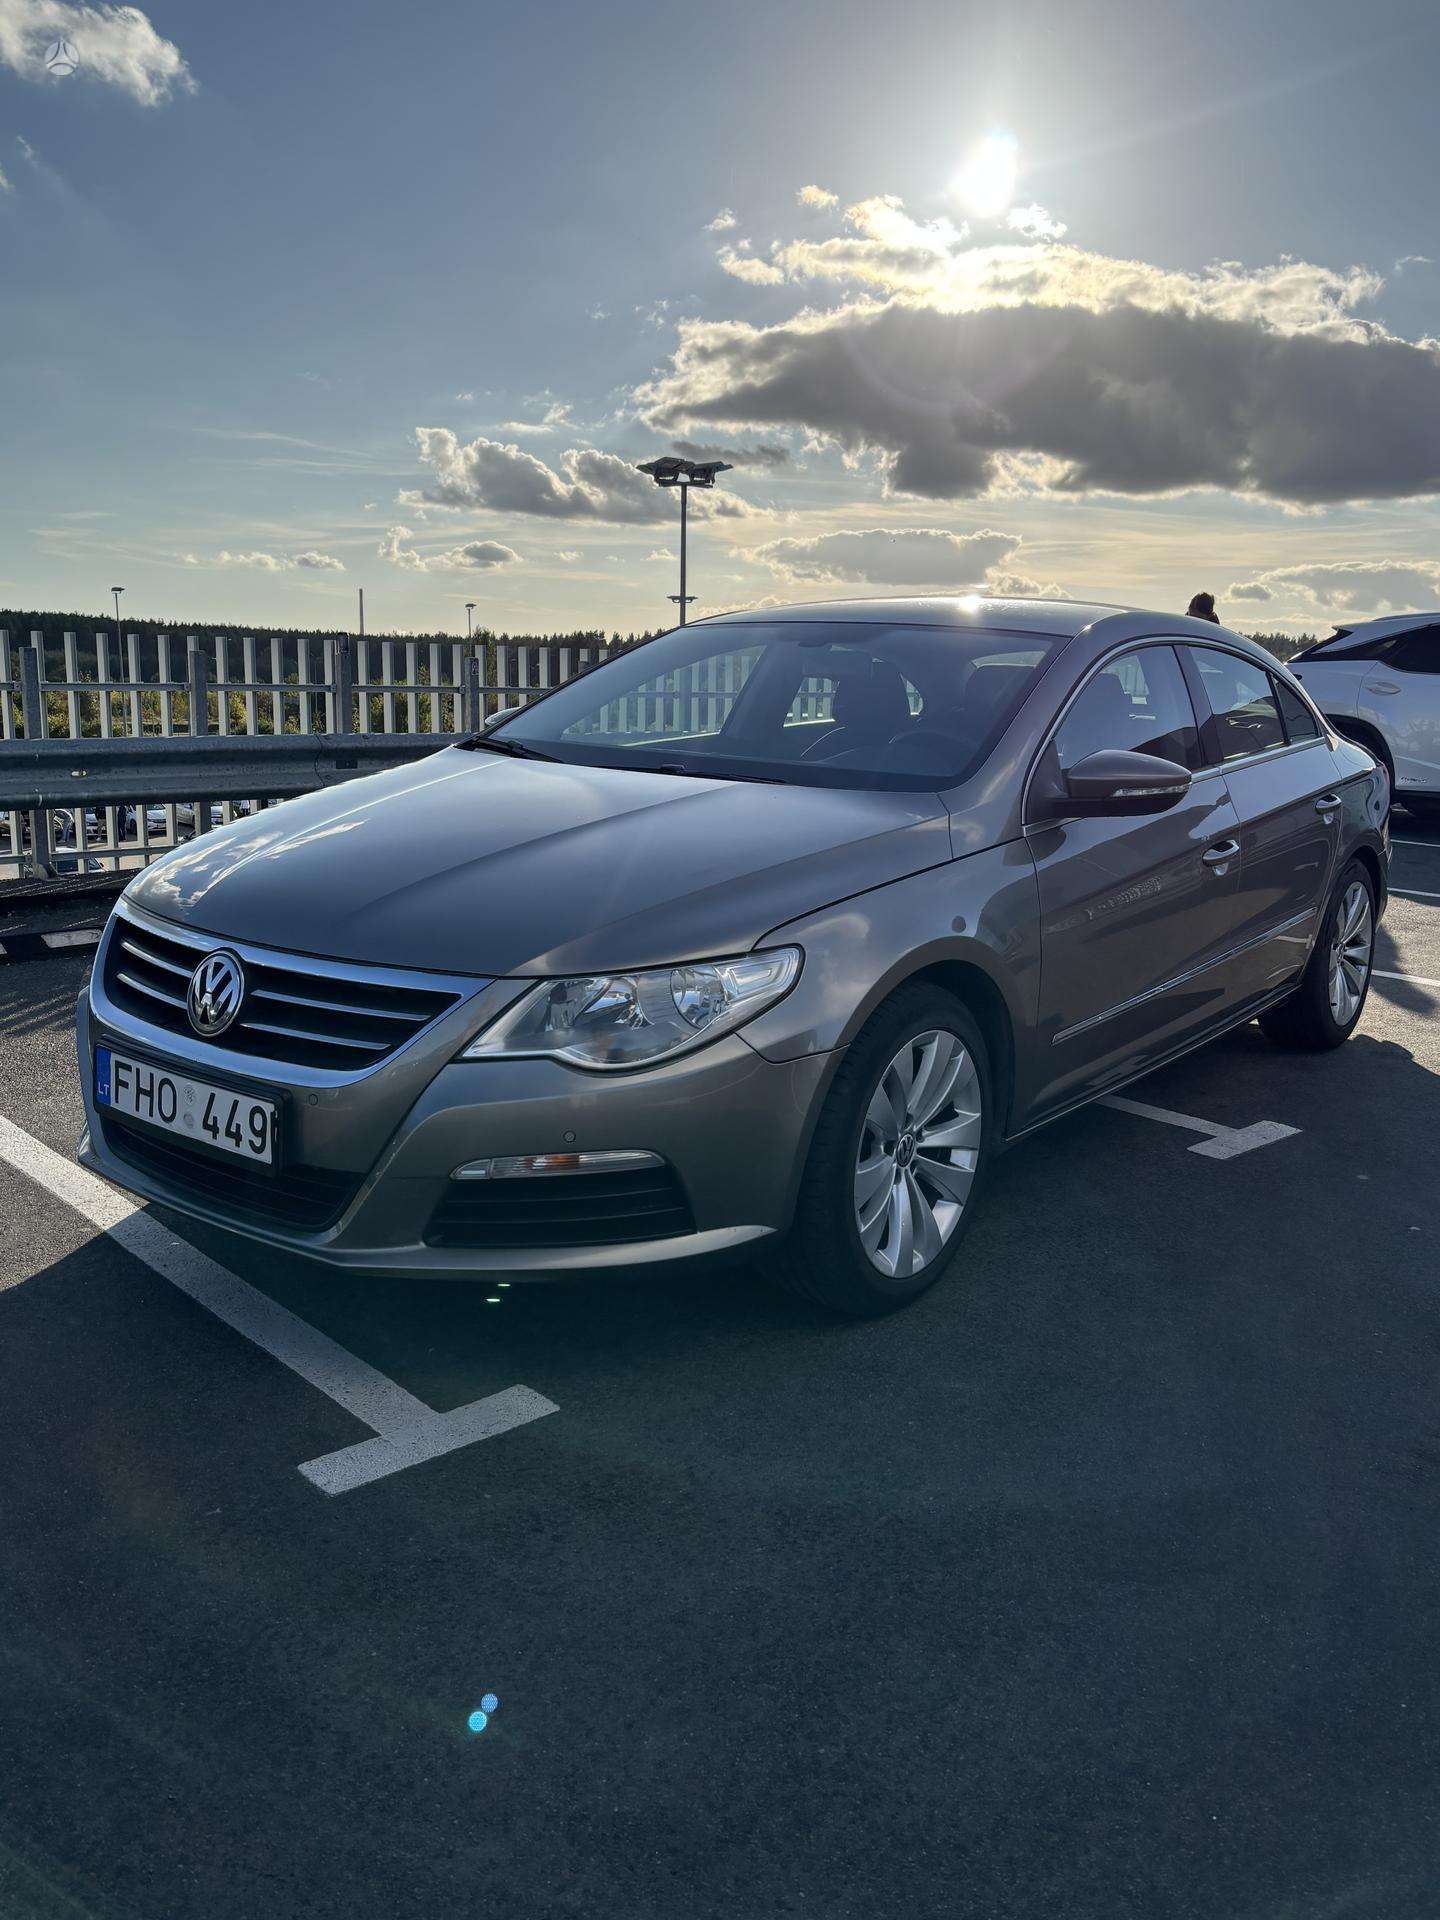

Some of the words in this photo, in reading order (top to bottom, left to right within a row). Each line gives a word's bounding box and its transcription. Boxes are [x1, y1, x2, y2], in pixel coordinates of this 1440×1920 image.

[190, 952, 244, 1035] VW
[97, 1081, 110, 1096] LT
[114, 1060, 177, 1124] FHO
[202, 1092, 268, 1155] 449
